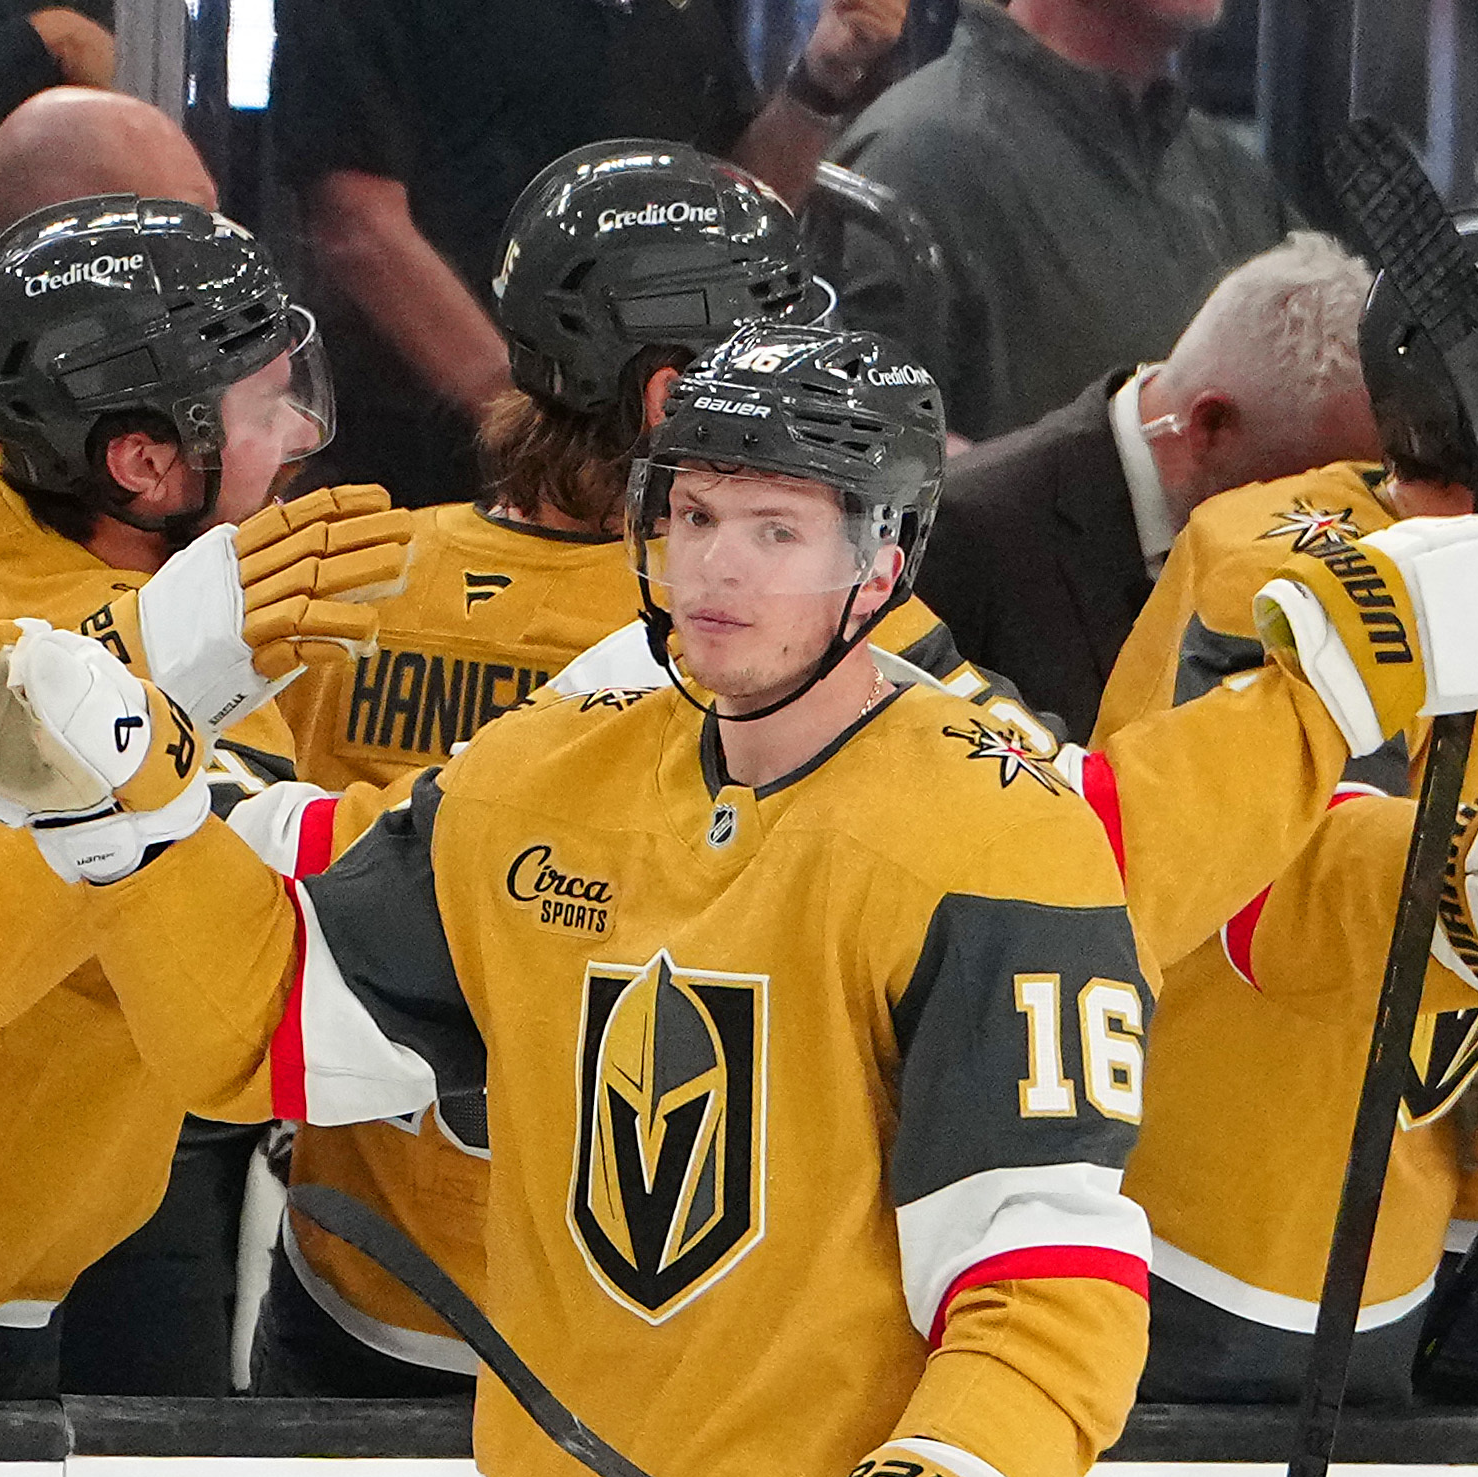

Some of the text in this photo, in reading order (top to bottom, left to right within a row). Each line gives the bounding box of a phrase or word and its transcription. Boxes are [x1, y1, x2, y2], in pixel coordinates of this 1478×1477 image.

[597, 202, 718, 232] CreditOne
[25, 254, 143, 297] CreditOne
[346, 649, 550, 755] HANIF
[507, 845, 613, 904] Circa
[540, 900, 608, 934] SPORTS
[1013, 972, 1146, 1127] 16
